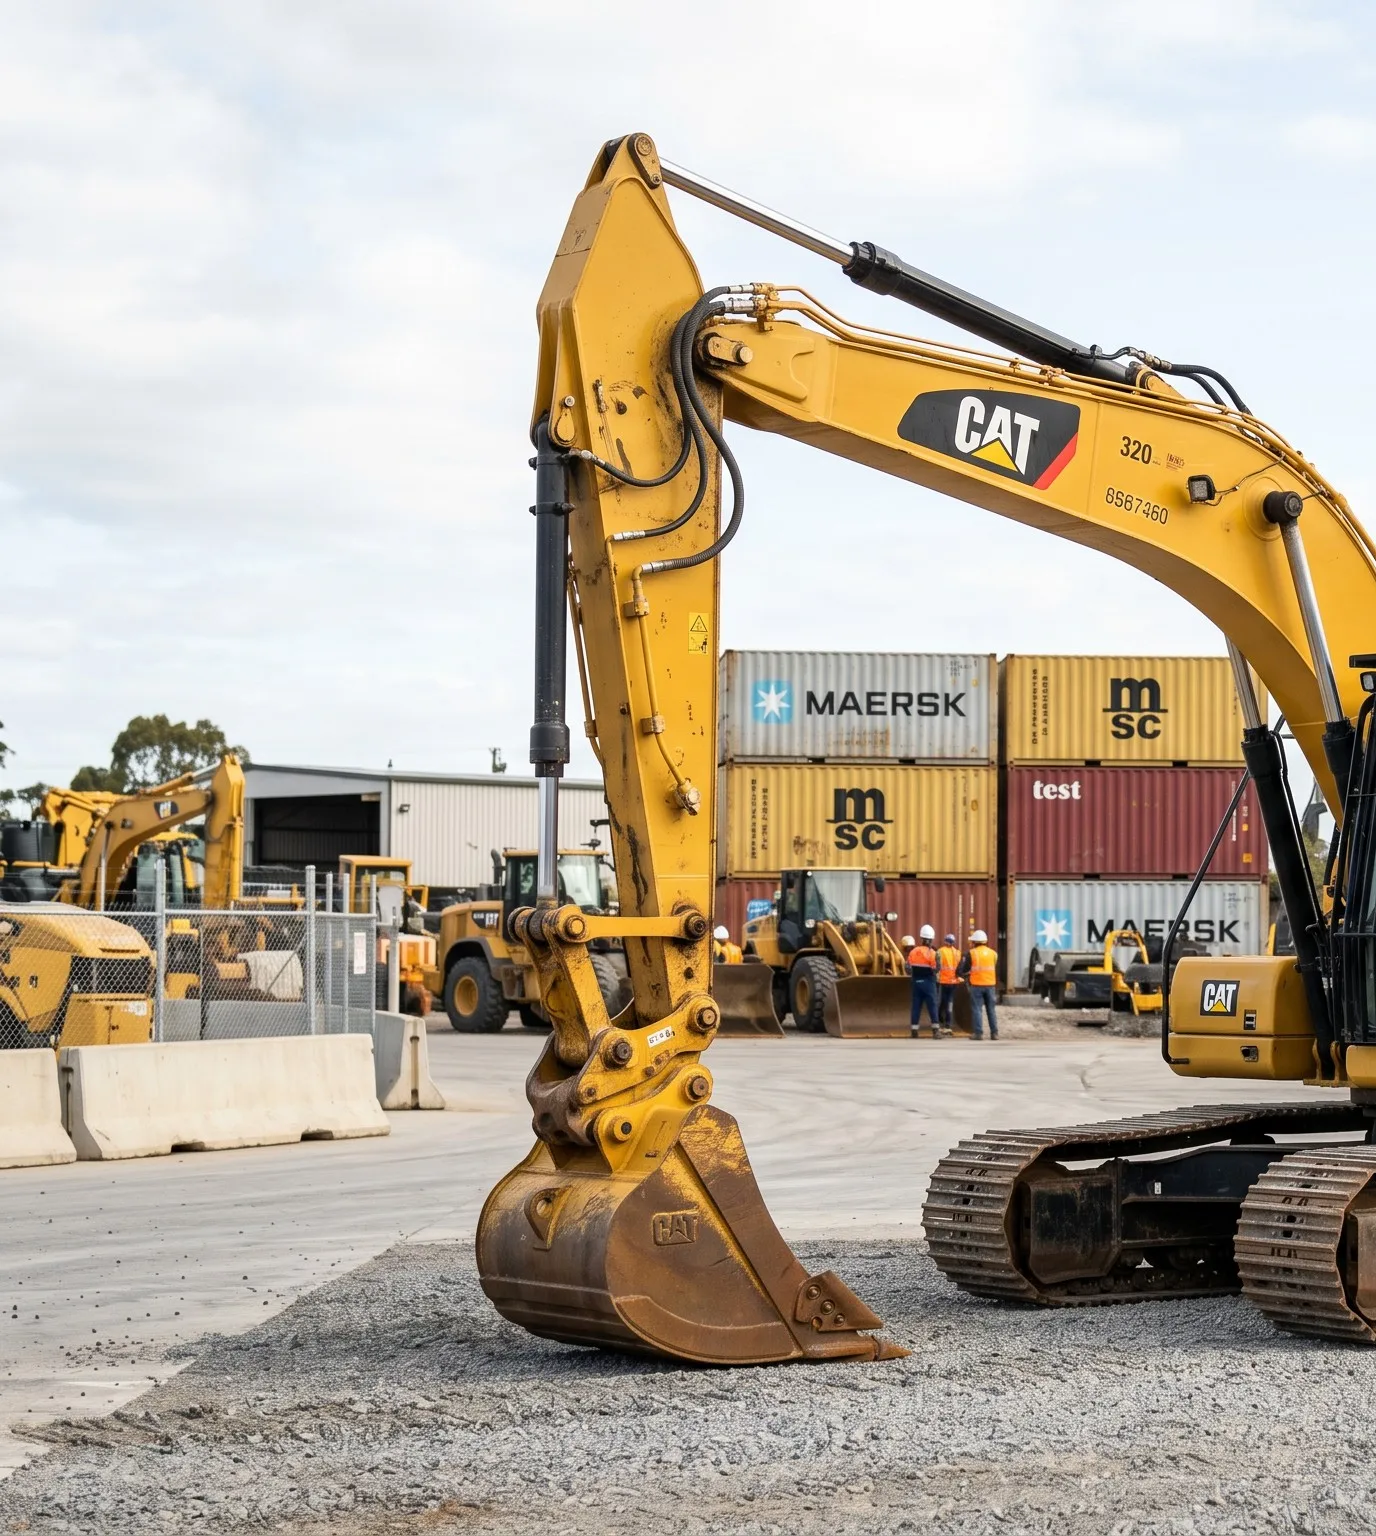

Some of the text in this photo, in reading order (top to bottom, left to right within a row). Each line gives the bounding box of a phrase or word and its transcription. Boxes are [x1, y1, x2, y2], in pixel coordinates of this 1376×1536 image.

[954, 396, 1040, 476] CAT
[1120, 435, 1152, 465] 320
[806, 690, 967, 718] MAERSK
[1033, 780, 1081, 800] test
[1203, 983, 1237, 1012] CAT
[652, 1210, 698, 1246] CAT
